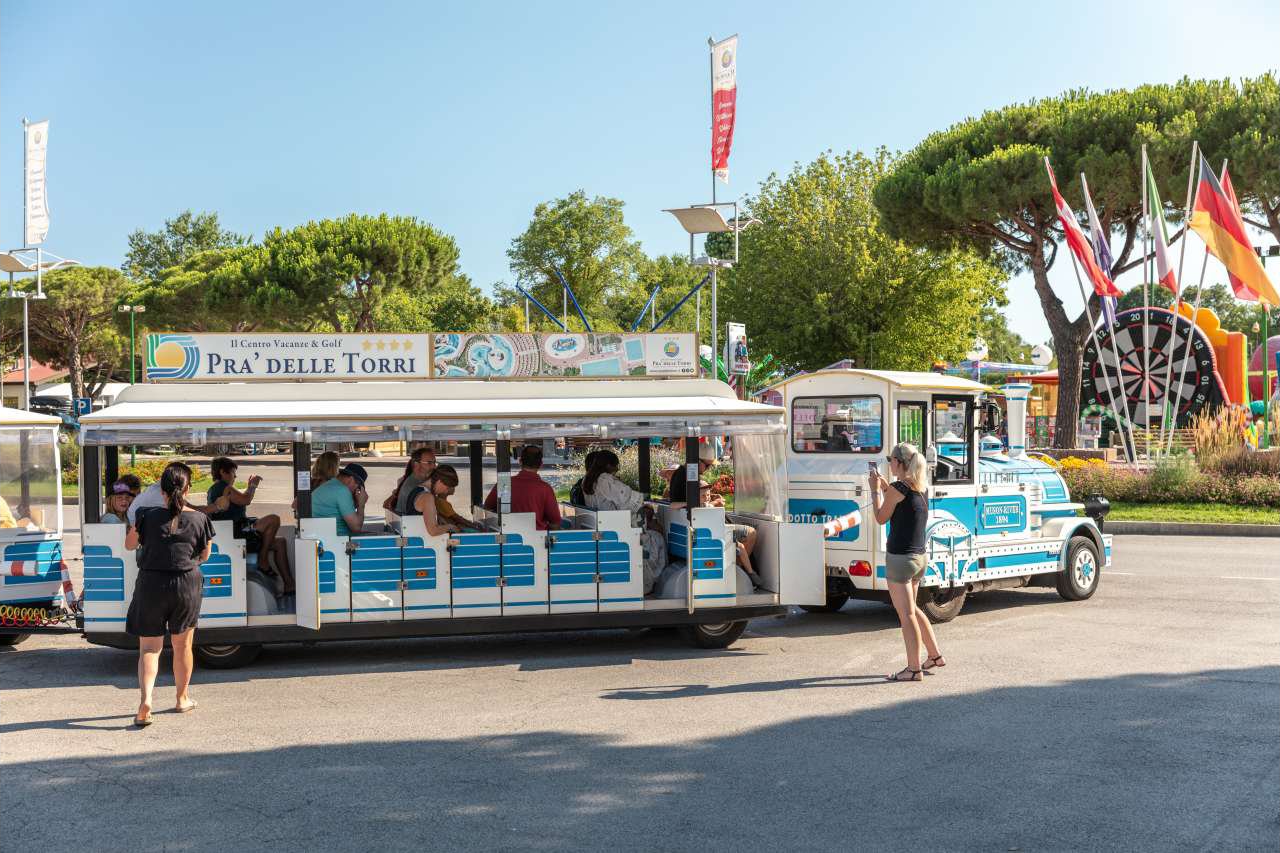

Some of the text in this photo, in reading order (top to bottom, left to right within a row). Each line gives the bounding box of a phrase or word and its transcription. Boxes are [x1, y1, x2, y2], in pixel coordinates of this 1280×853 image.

[1130, 313, 1140, 321] 20
[1096, 330, 1107, 340] 12
[230, 339, 343, 348] Il Centro Vacanze & Golf
[1194, 340, 1204, 350] 13
[266, 357, 336, 374] DELLE
[342, 352, 416, 374] TORRI
[1083, 361, 1090, 371] 14
[1083, 379, 1090, 388] 11
[1201, 376, 1209, 385] 10
[78, 401, 87, 412] P
[788, 513, 818, 524] DOTTO
